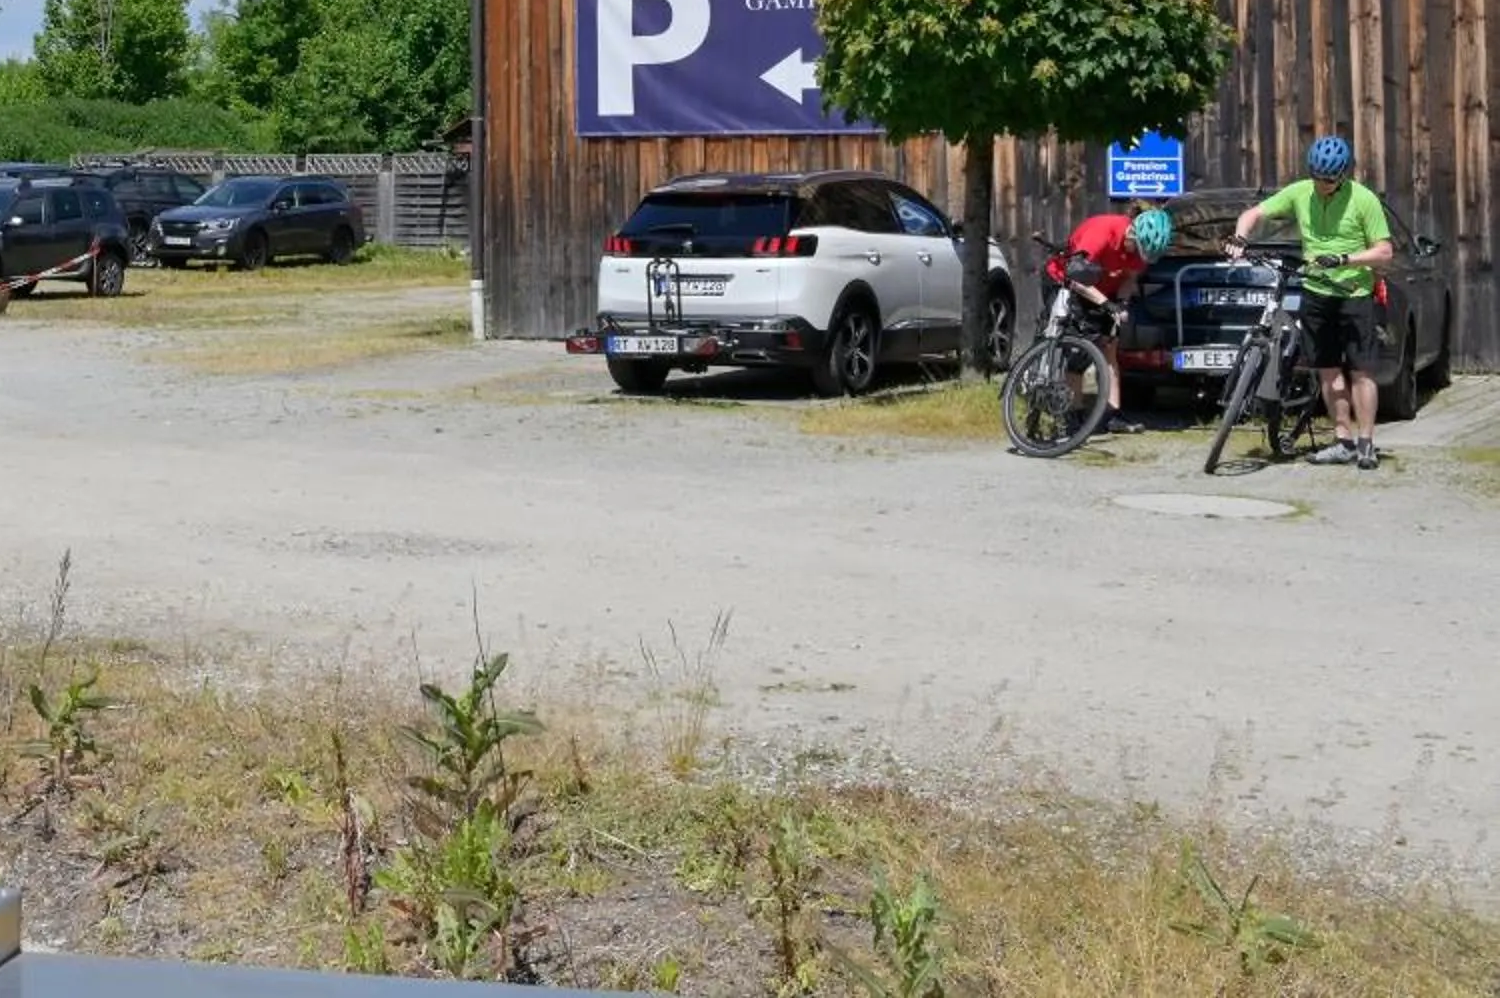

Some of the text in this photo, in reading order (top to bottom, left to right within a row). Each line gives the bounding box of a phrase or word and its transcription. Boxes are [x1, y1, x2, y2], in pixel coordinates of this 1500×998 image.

[1123, 162, 1168, 171] Pension
[1115, 171, 1176, 181] Gambrinus
[1184, 352, 1195, 366] M
[1204, 352, 1223, 366] EE
